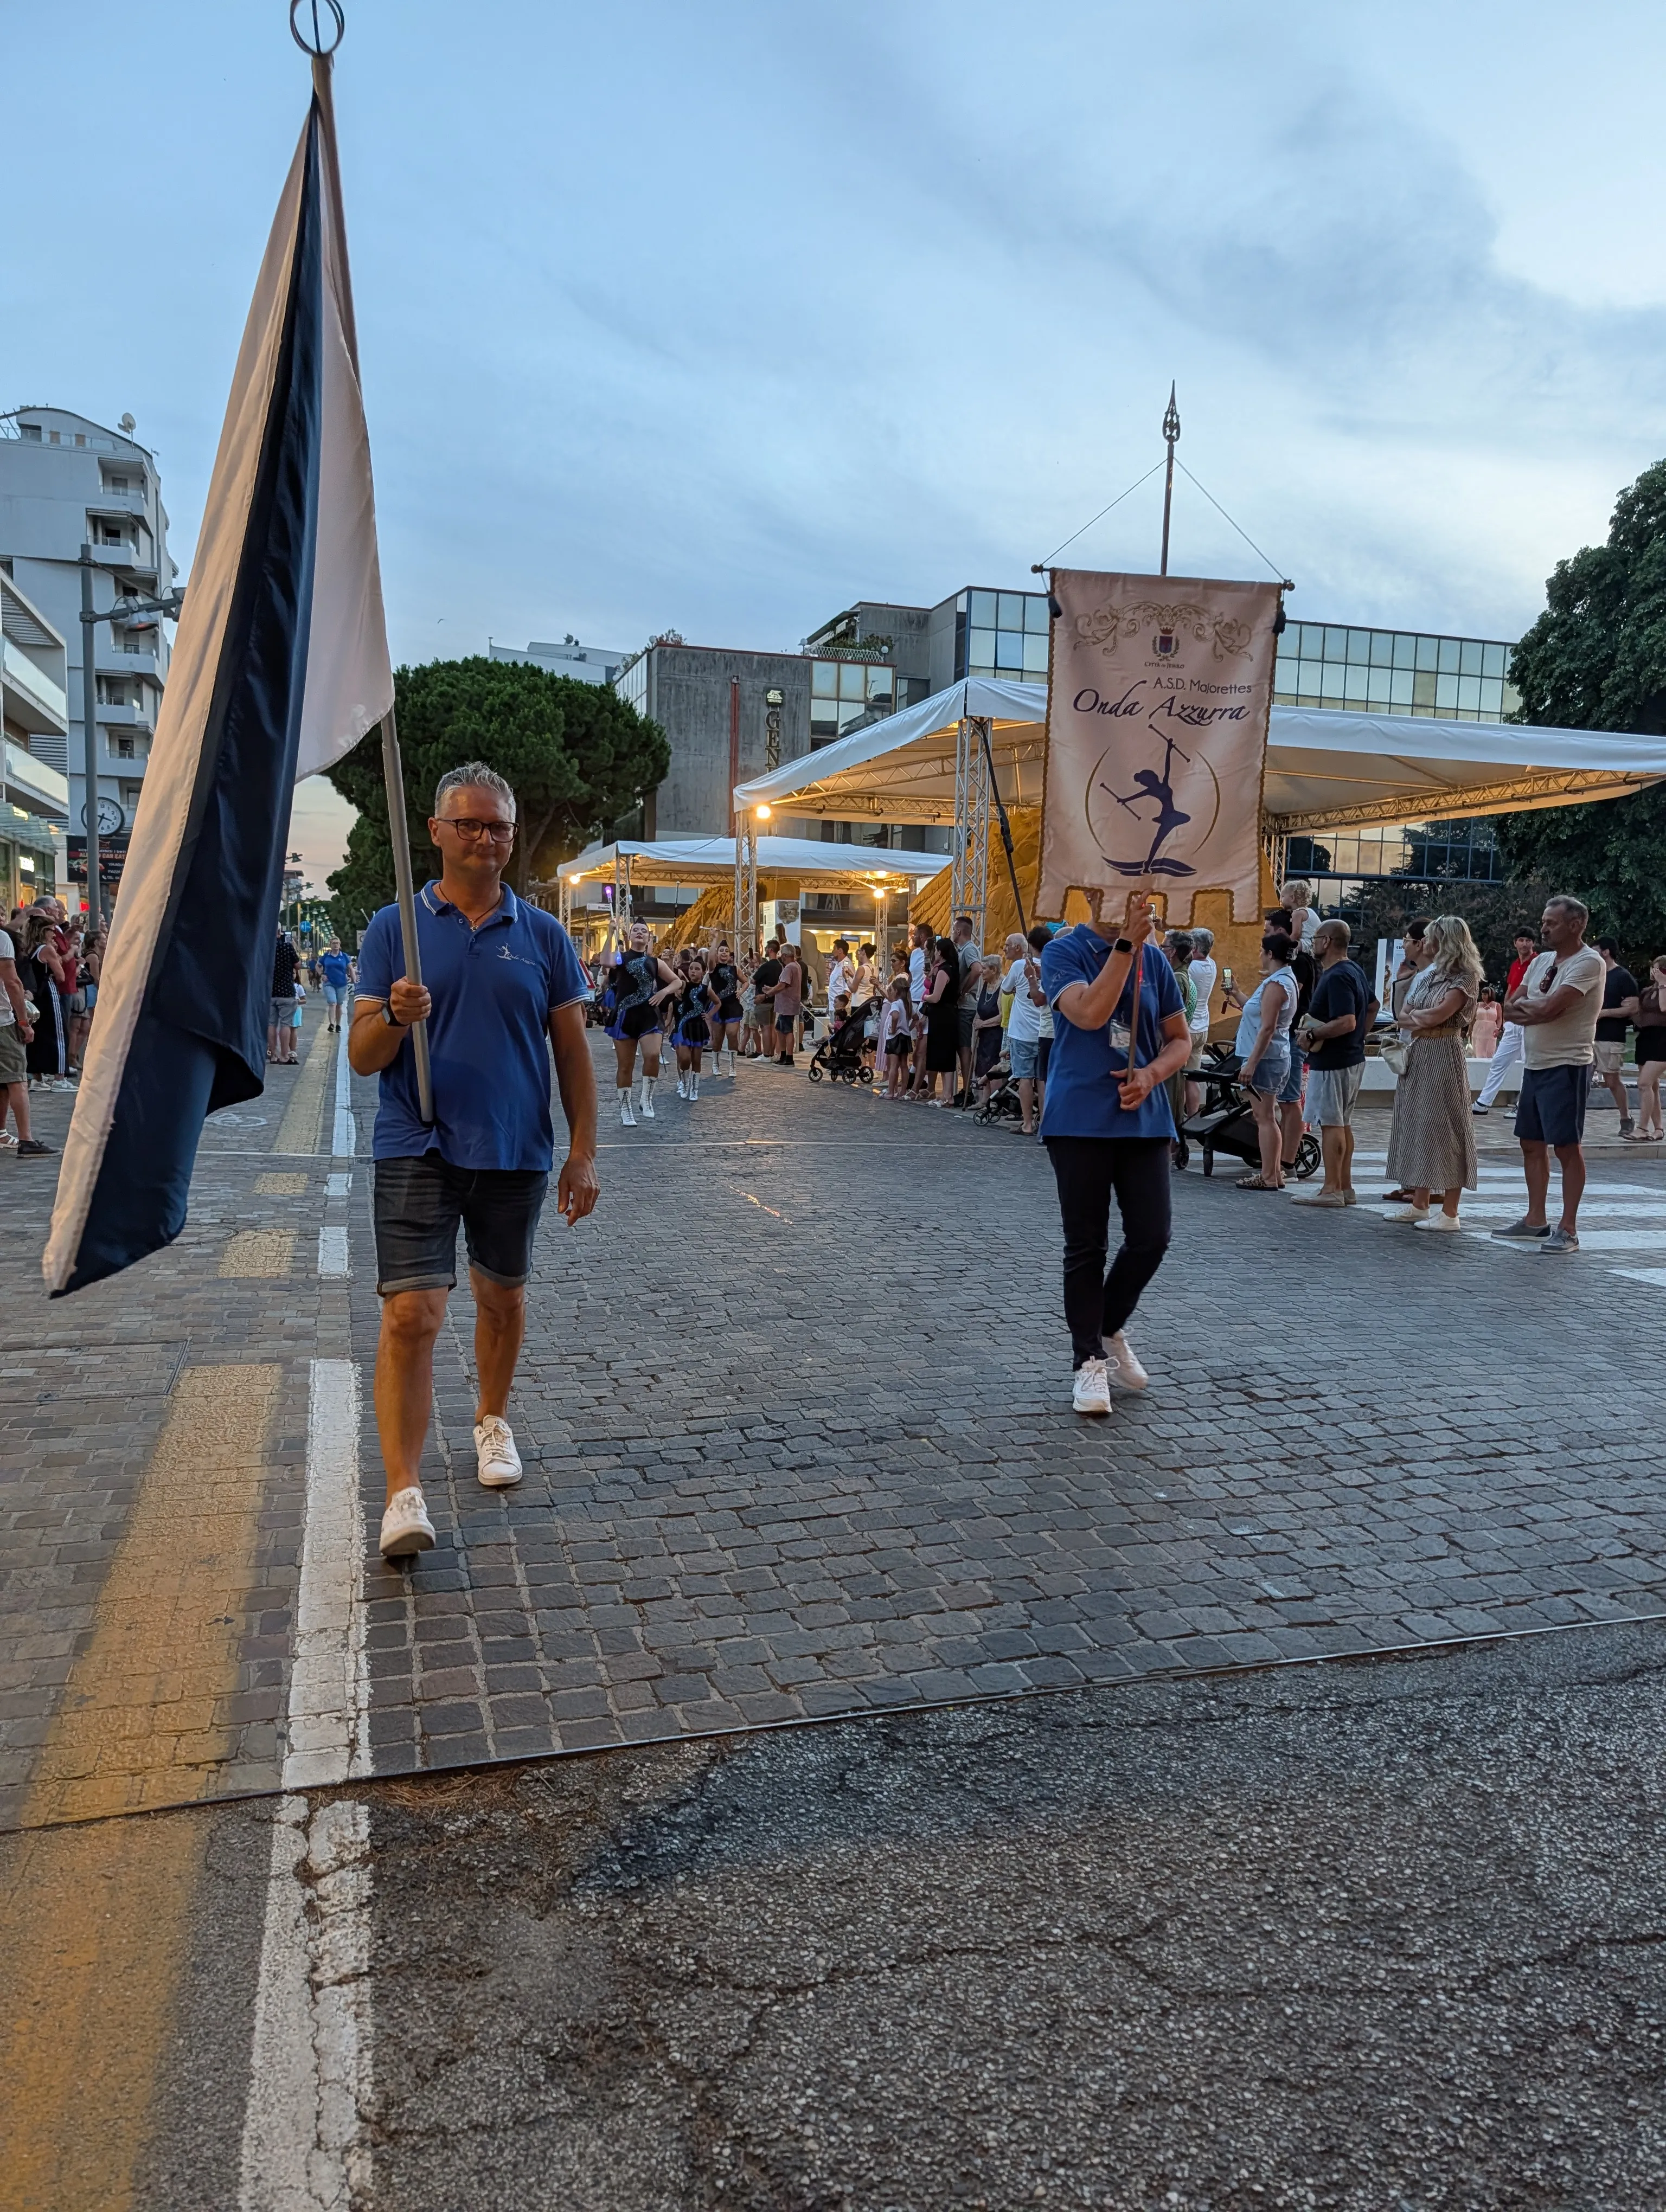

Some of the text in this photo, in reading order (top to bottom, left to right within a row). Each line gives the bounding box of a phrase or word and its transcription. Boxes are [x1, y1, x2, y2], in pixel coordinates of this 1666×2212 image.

[1154, 677, 1252, 695] A.S.D. Majorettes
[1073, 680, 1251, 726] Onda Azzurra
